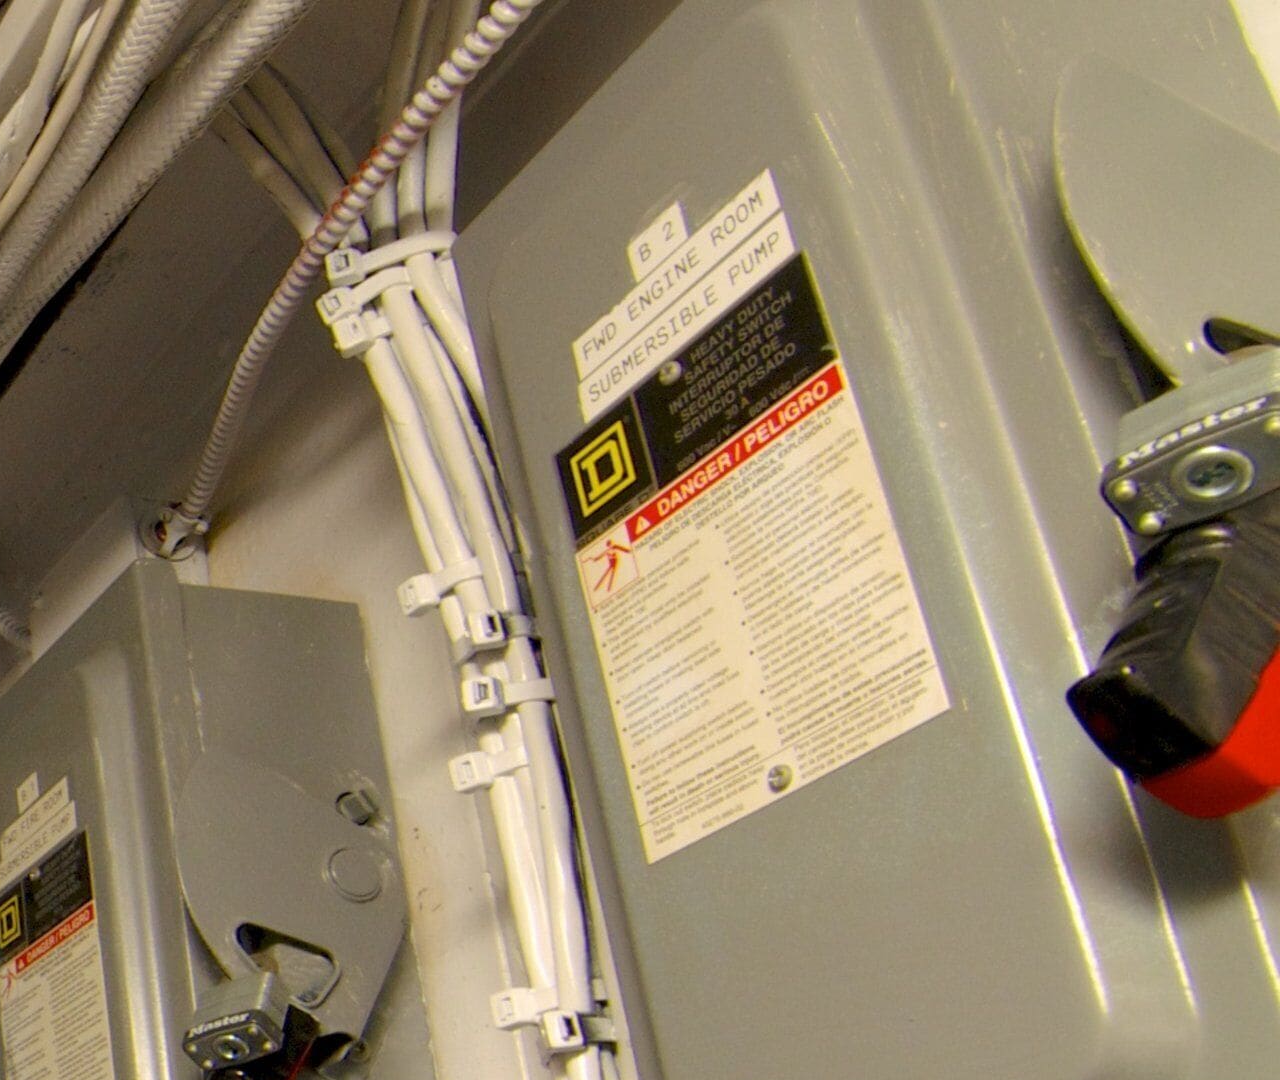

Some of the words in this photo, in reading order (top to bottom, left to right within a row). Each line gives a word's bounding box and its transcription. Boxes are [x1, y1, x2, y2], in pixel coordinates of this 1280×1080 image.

[582, 321, 618, 361] FWD
[625, 247, 701, 322] ENGINE
[708, 190, 764, 248] ROOM
[638, 243, 651, 263] B
[662, 221, 674, 242] 2
[588, 284, 719, 403] SUBMERSIBLE
[727, 231, 780, 287] PUMP
[684, 338, 732, 383] SAFETY
[738, 292, 791, 340] SWITCH
[690, 320, 732, 362] HEAVY
[737, 287, 772, 323] DUTY
[669, 335, 760, 412] INTERRUPTOR
[764, 315, 783, 337] DE
[674, 390, 734, 442] SERVICIO
[738, 343, 795, 392] PESADO
[681, 355, 756, 420] SEGURIDAD
[760, 336, 780, 358] DE
[741, 396, 749, 408] A
[658, 454, 729, 514] DANGER
[744, 382, 827, 449] PELIGRO
[188, 1012, 250, 1038] Master
